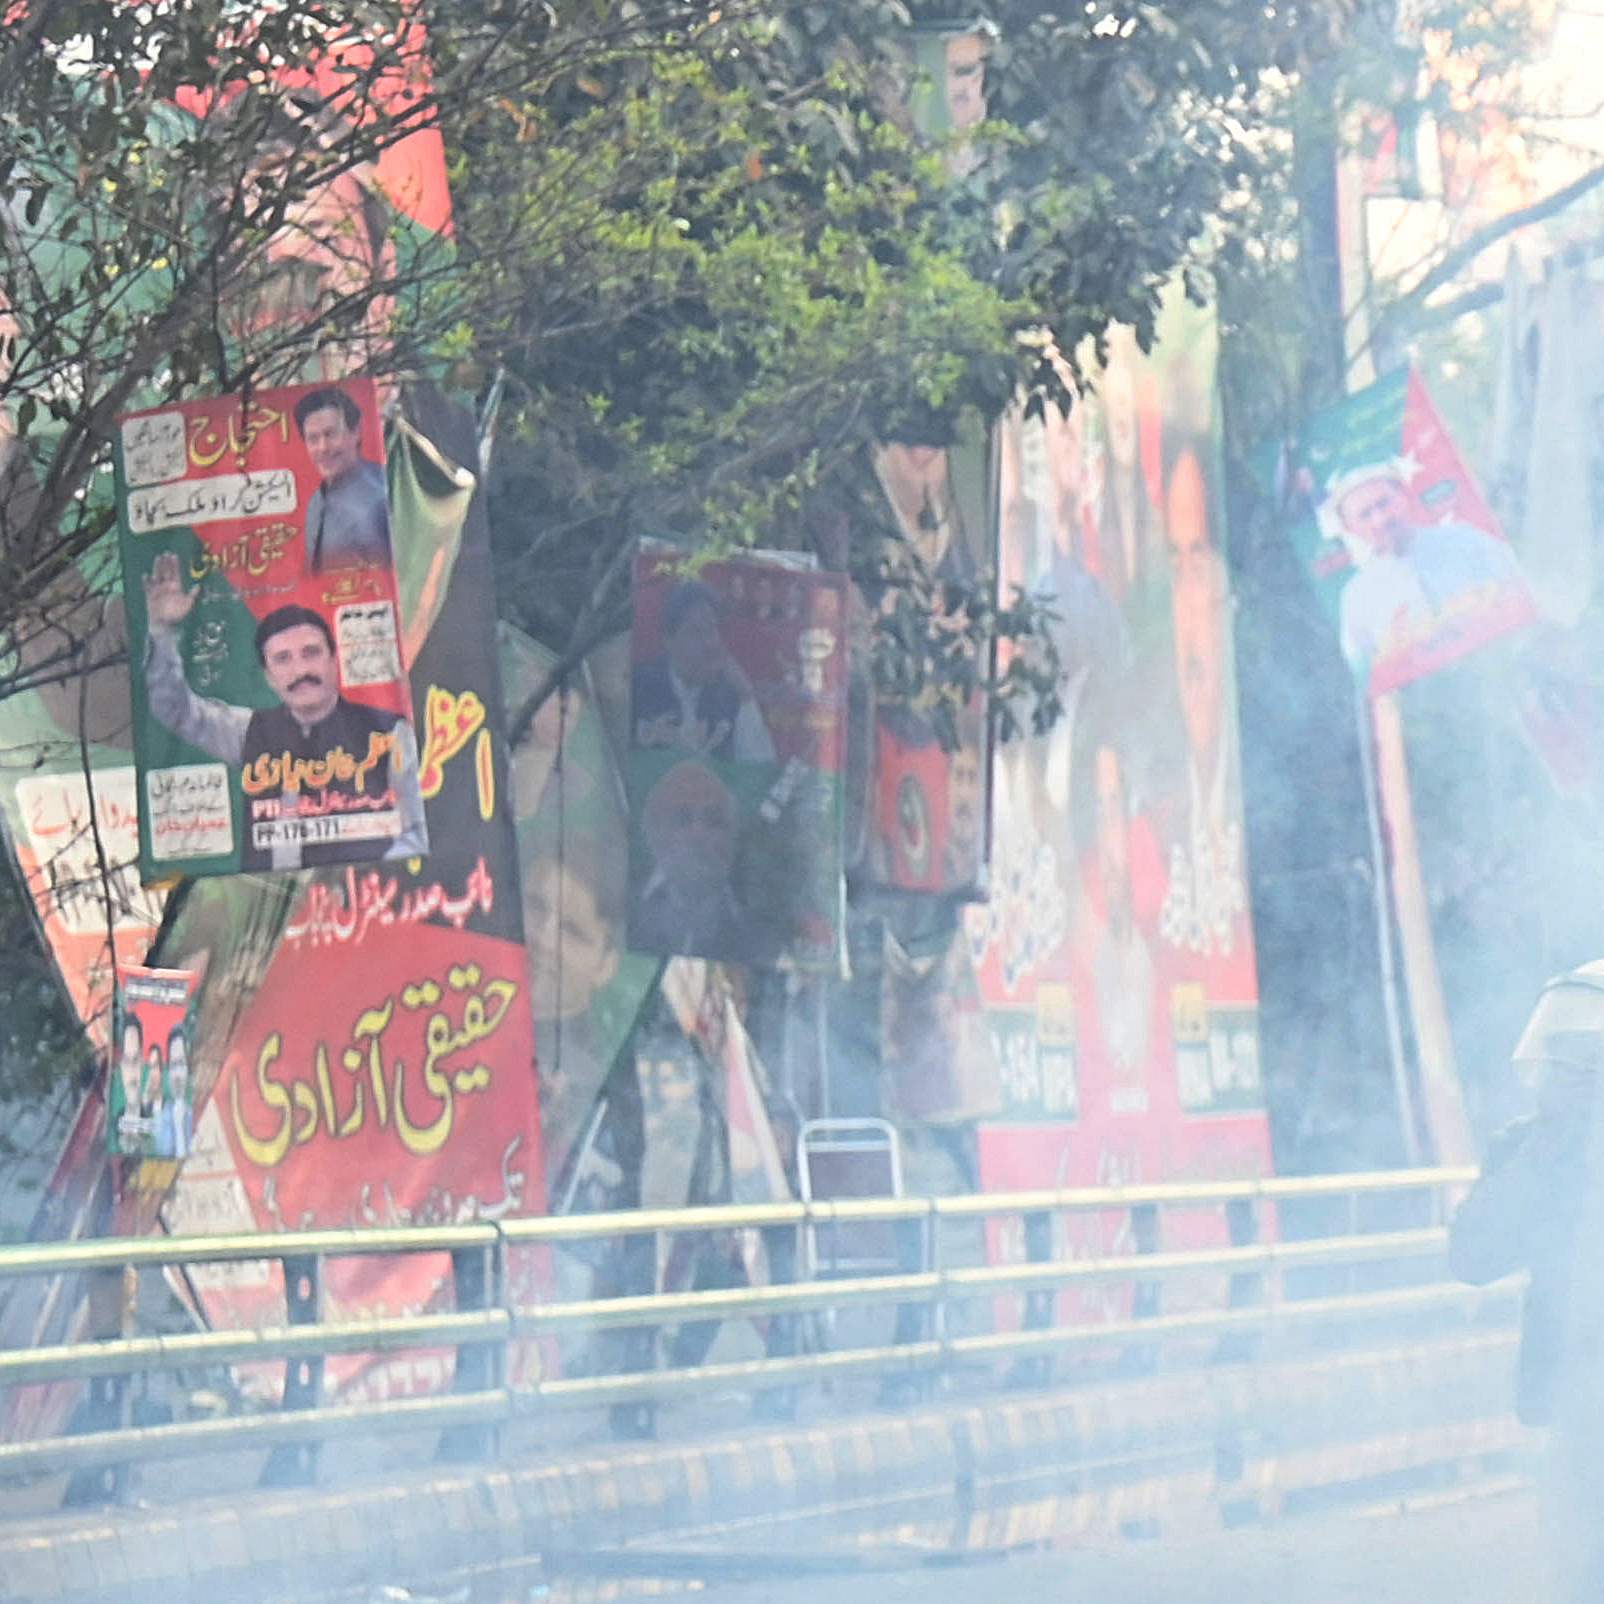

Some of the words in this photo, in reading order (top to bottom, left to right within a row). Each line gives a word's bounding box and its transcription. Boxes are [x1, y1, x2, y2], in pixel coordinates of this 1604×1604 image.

[189, 400, 290, 466] احتجاج
[248, 522, 299, 577] حقیقی
[229, 997, 395, 1168] آزادی
[393, 962, 518, 1156] حقیقی
